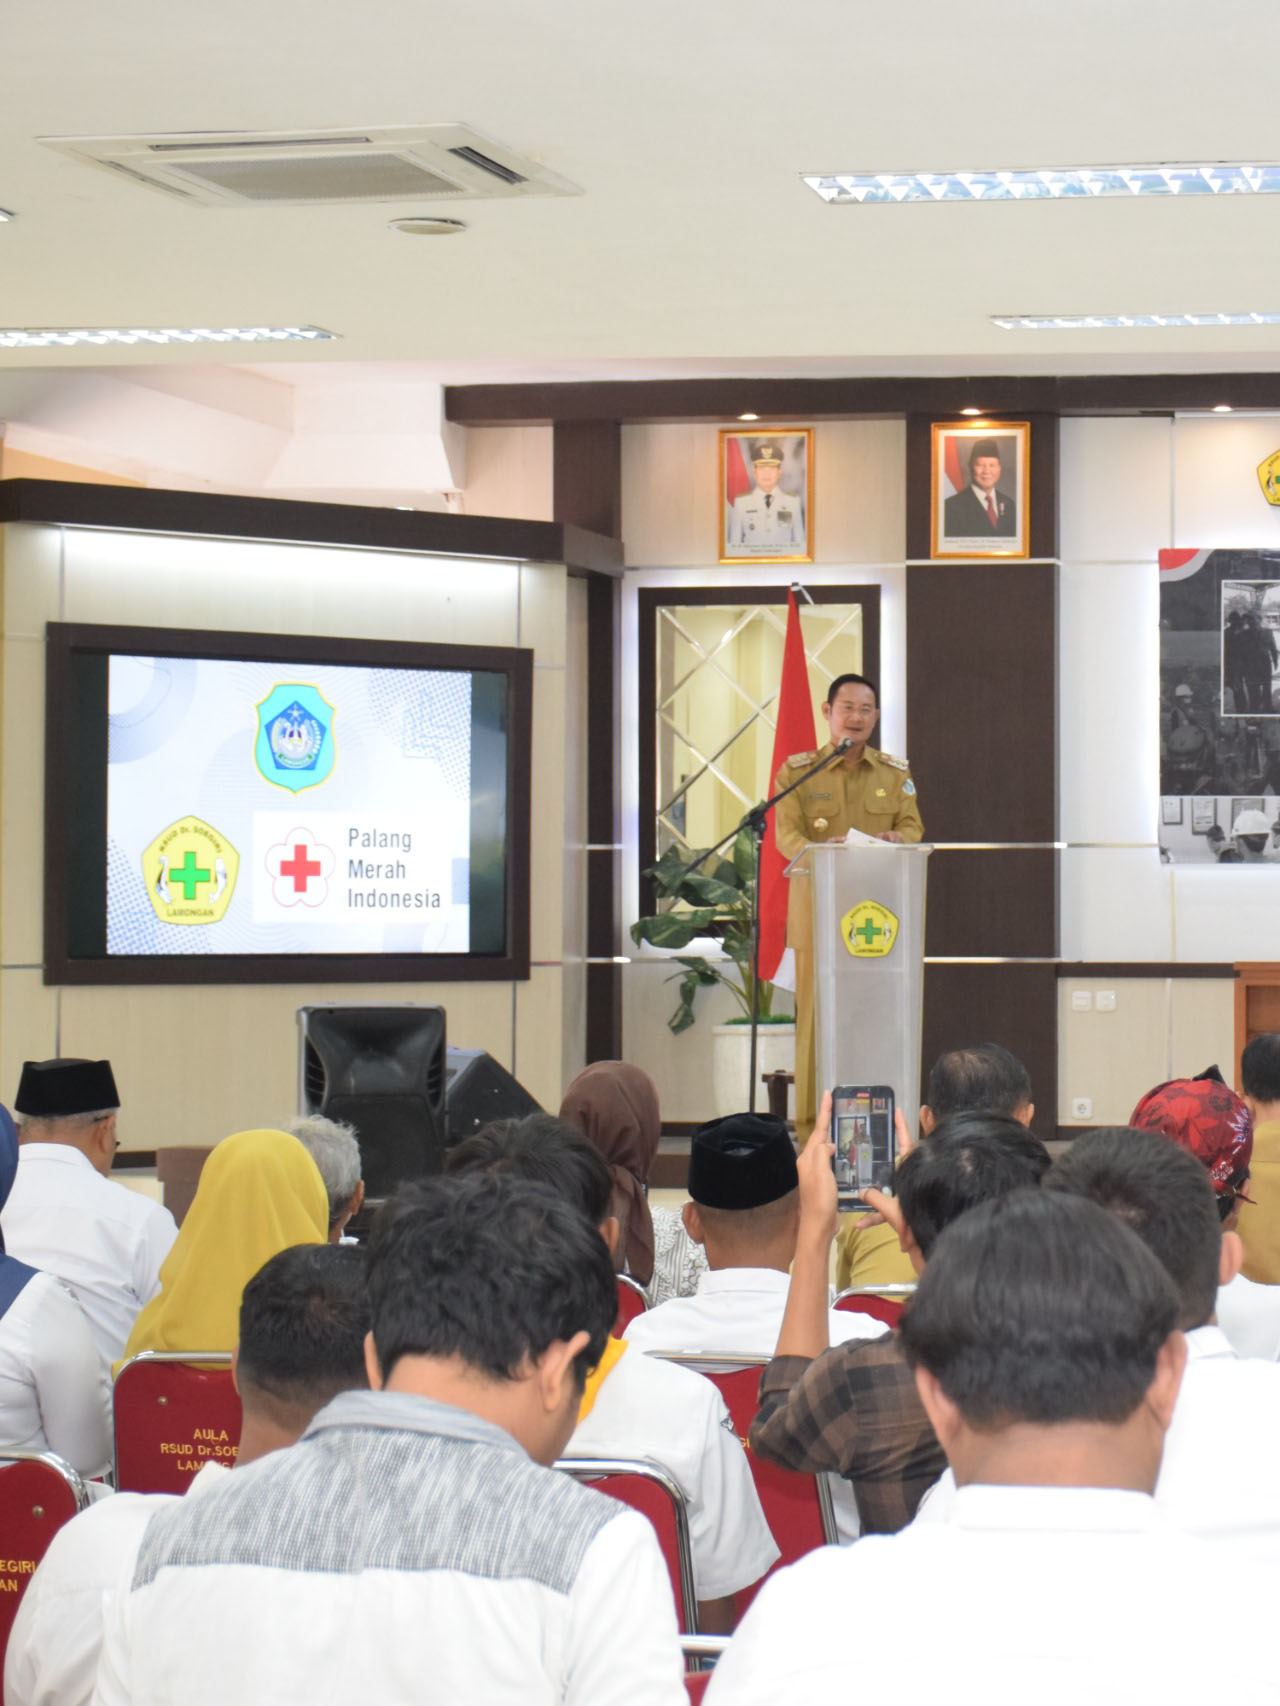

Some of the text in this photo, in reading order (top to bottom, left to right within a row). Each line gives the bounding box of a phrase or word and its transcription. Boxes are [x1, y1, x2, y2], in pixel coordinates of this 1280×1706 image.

[348, 827, 412, 853] Palang
[348, 859, 406, 879] Merah
[348, 888, 441, 908] Indonesia
[193, 1428, 229, 1442] AULA
[160, 1443, 239, 1457] RSUD Dr.SOE
[0, 1560, 36, 1573] EGIRI
